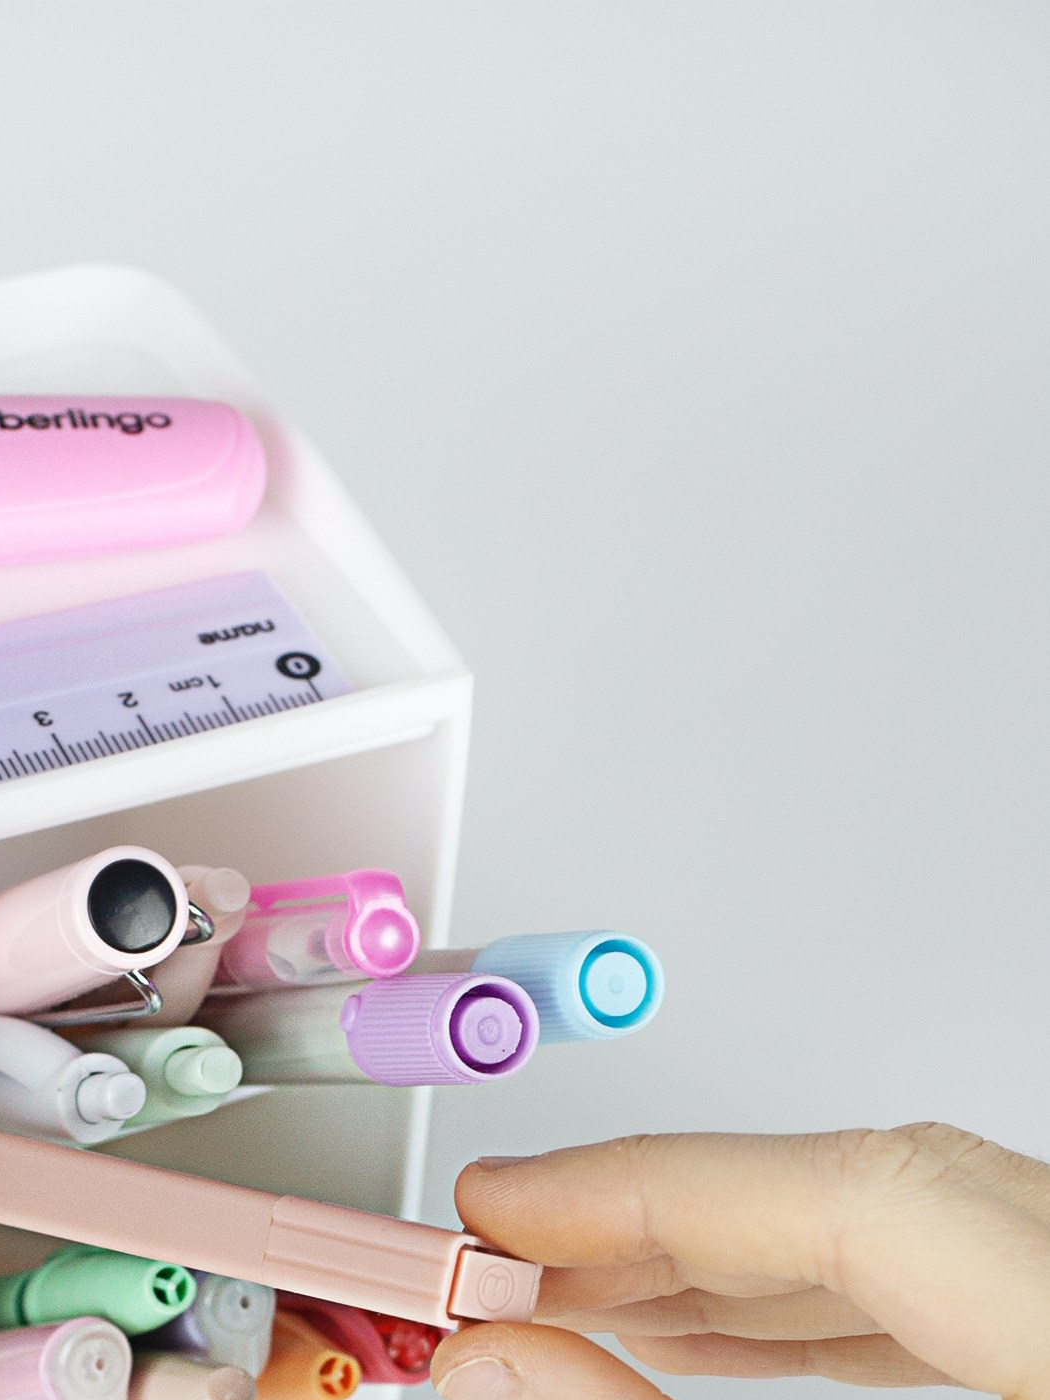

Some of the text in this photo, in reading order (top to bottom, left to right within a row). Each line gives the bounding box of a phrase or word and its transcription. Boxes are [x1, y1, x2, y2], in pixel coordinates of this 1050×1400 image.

[198, 619, 276, 645] name
[118, 691, 139, 708] 2
[33, 711, 54, 727] 3
